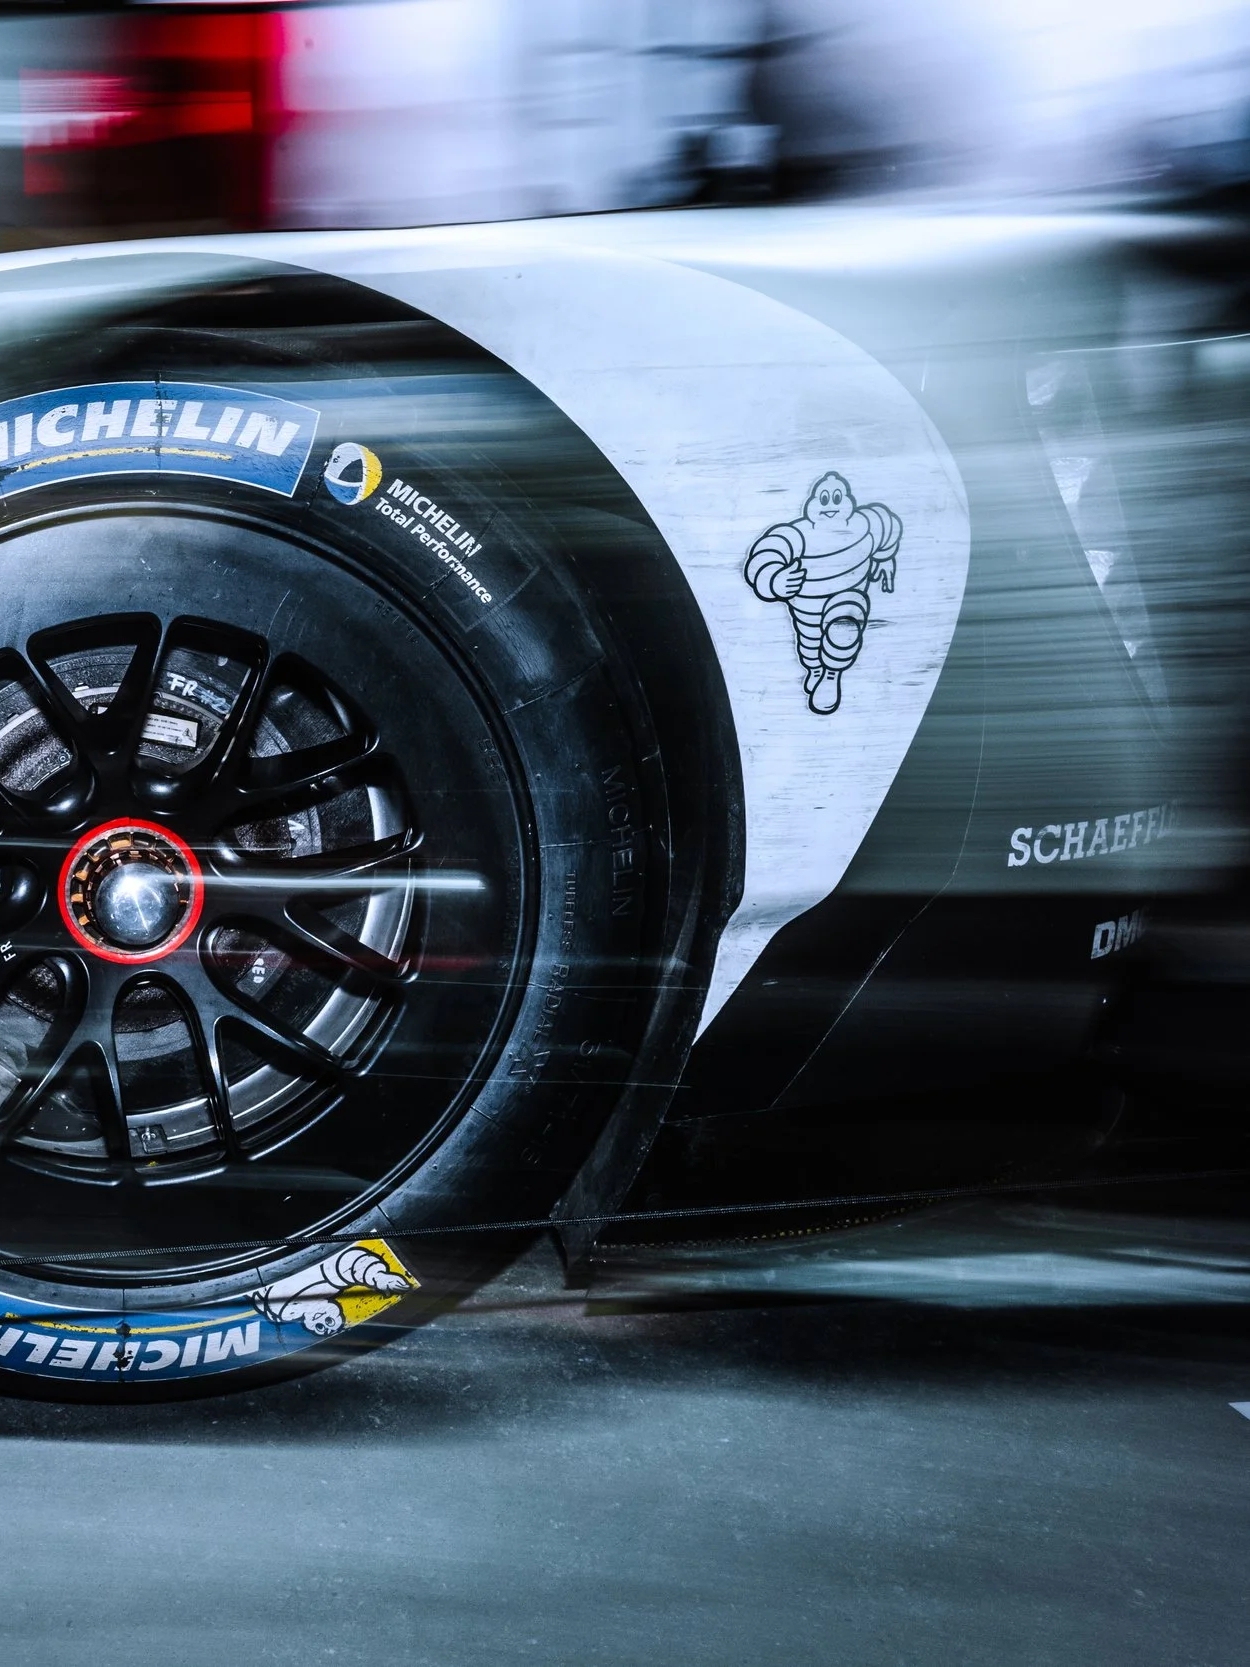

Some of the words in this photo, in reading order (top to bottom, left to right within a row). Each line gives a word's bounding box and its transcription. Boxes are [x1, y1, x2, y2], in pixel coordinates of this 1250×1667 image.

[375, 497, 415, 529] Total
[410, 523, 492, 604] Performance
[386, 478, 482, 557] MICHELIN
[167, 671, 198, 696] FR
[600, 763, 634, 917] MICHELIN
[0, 941, 16, 961] FR
[540, 963, 571, 1042] RADIAL
